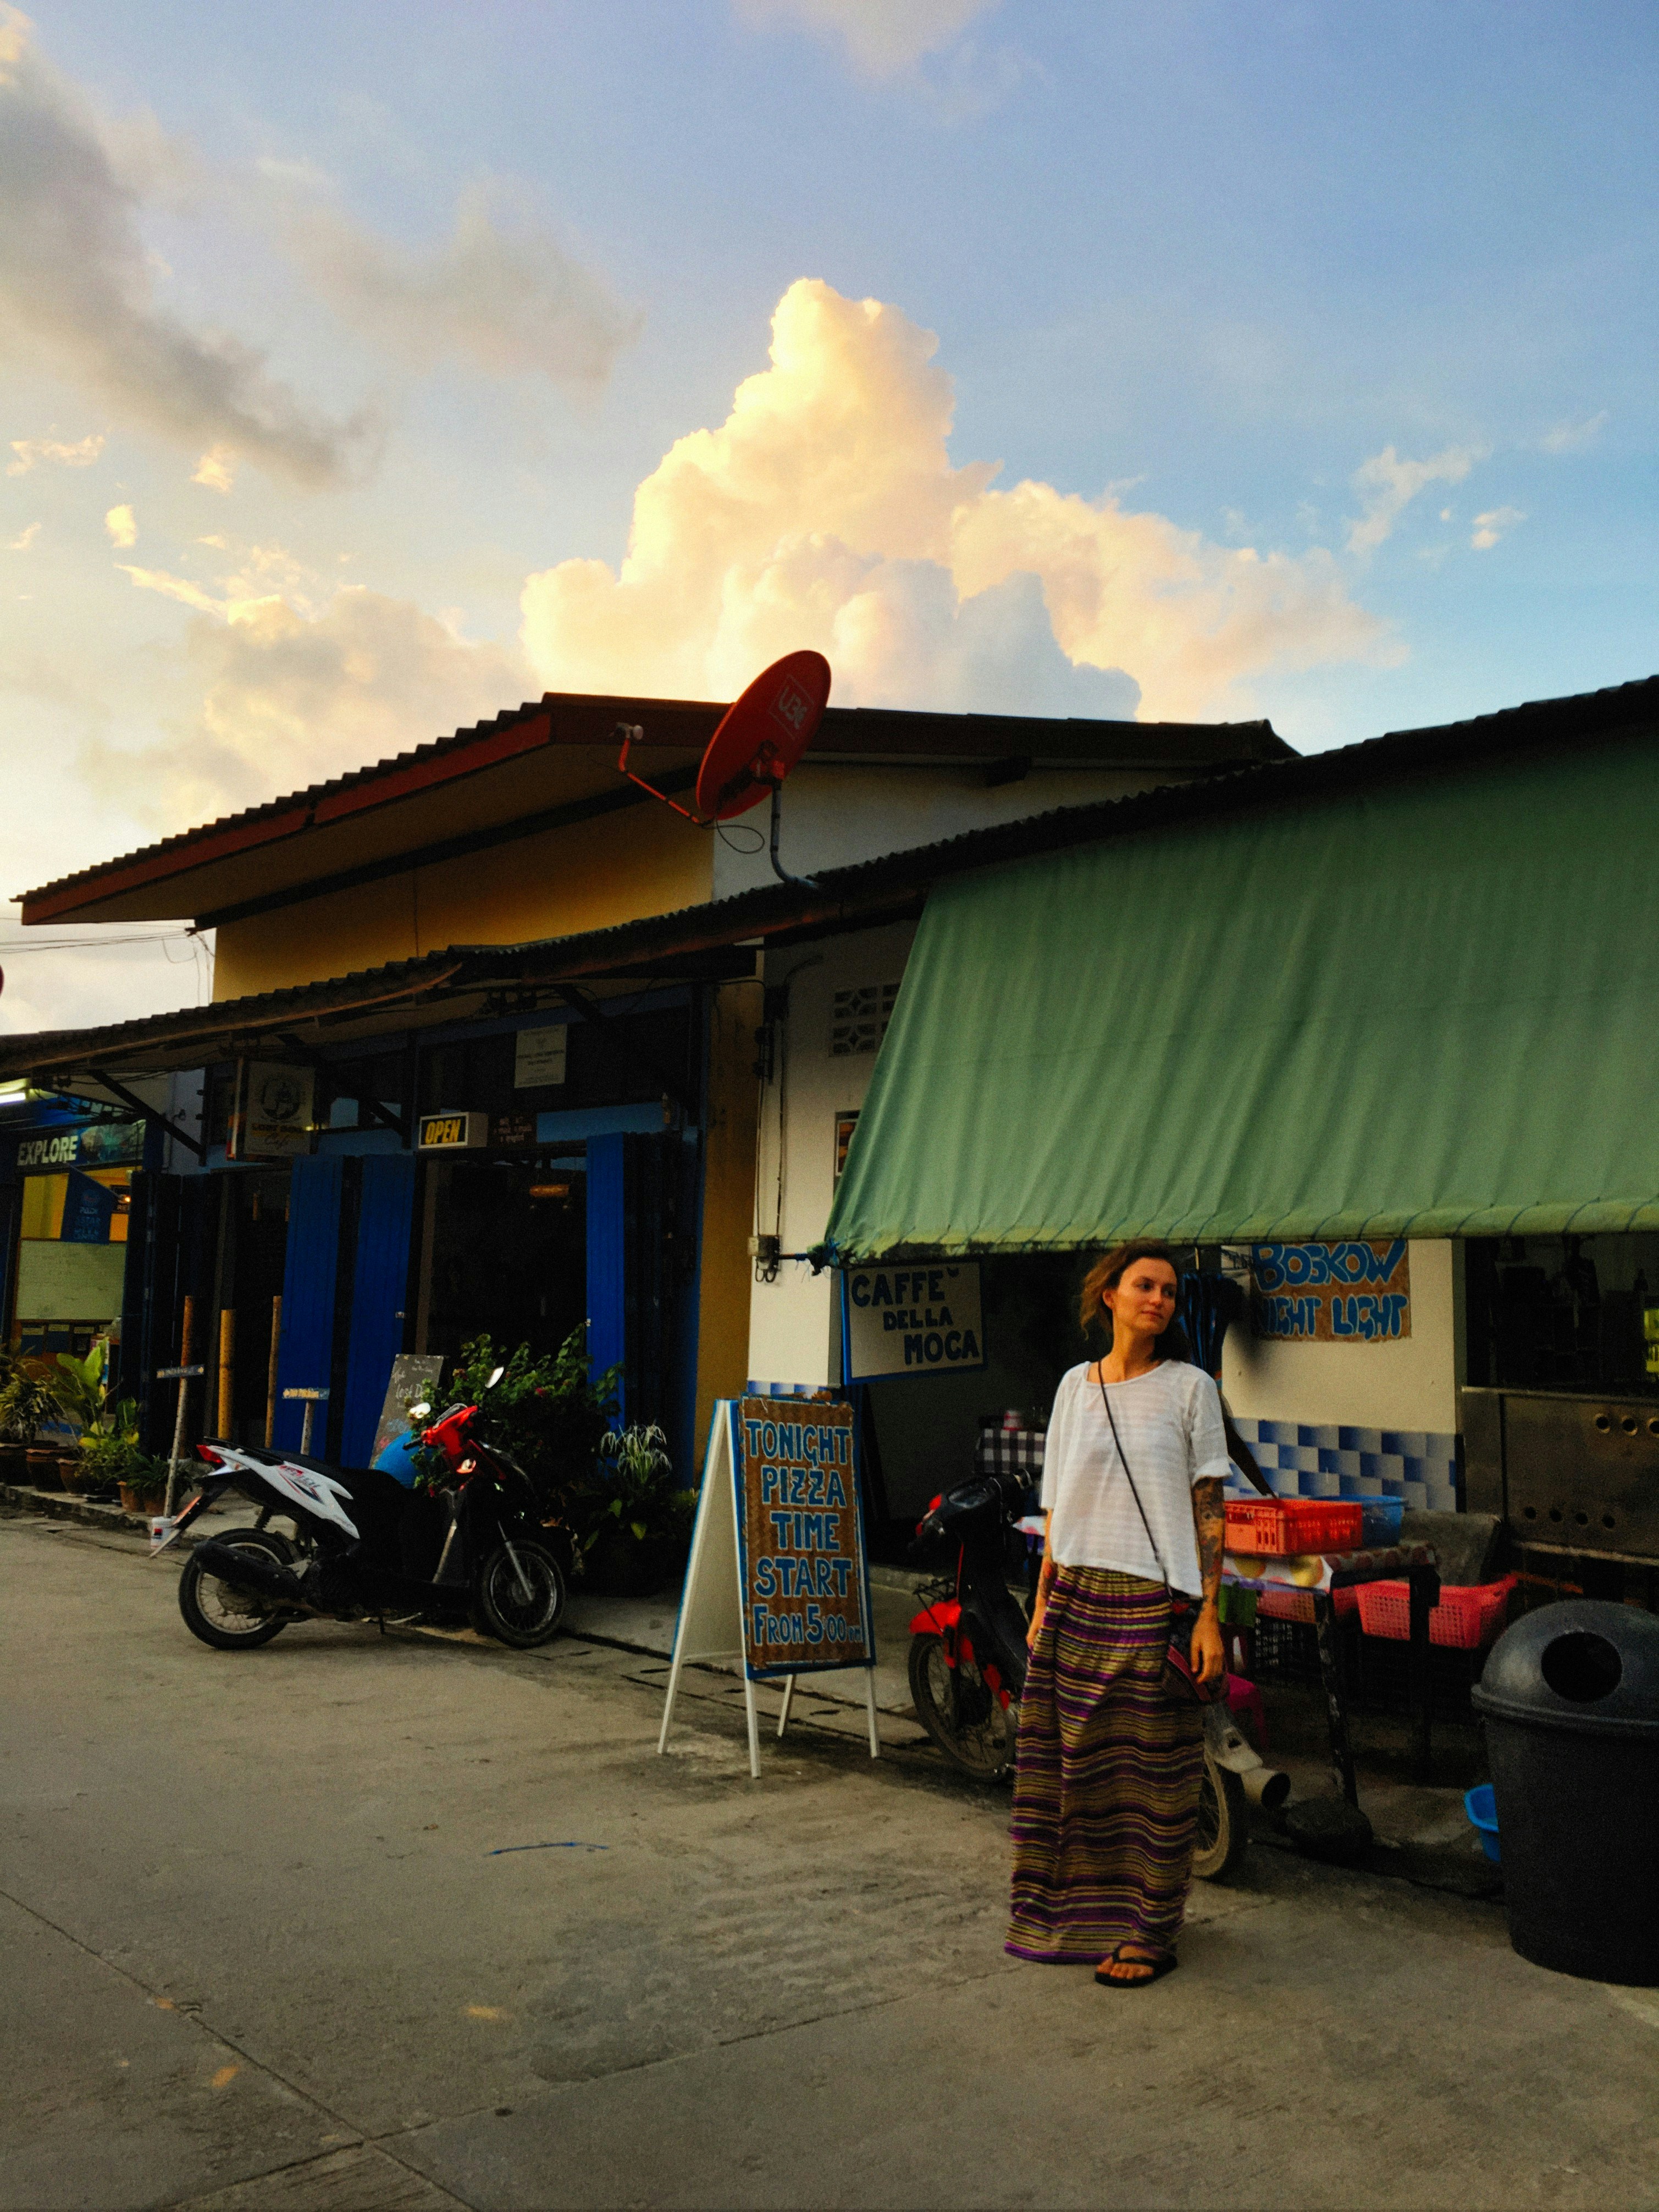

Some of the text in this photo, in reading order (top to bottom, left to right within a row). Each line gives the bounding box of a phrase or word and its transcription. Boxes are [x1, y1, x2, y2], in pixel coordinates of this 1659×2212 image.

[17, 1135, 79, 1166] EXPLORE
[424, 1118, 461, 1144] OPEN
[883, 1306, 953, 1331] DELLA
[1331, 1294, 1408, 1340] LIGHT
[904, 1330, 980, 1365] MOCA
[745, 1418, 852, 1467] TONIGHT
[761, 1465, 846, 1508] PIZZA
[770, 1511, 840, 1552] TIME
[754, 1556, 853, 1597] START
[753, 1603, 805, 1646] FROM
